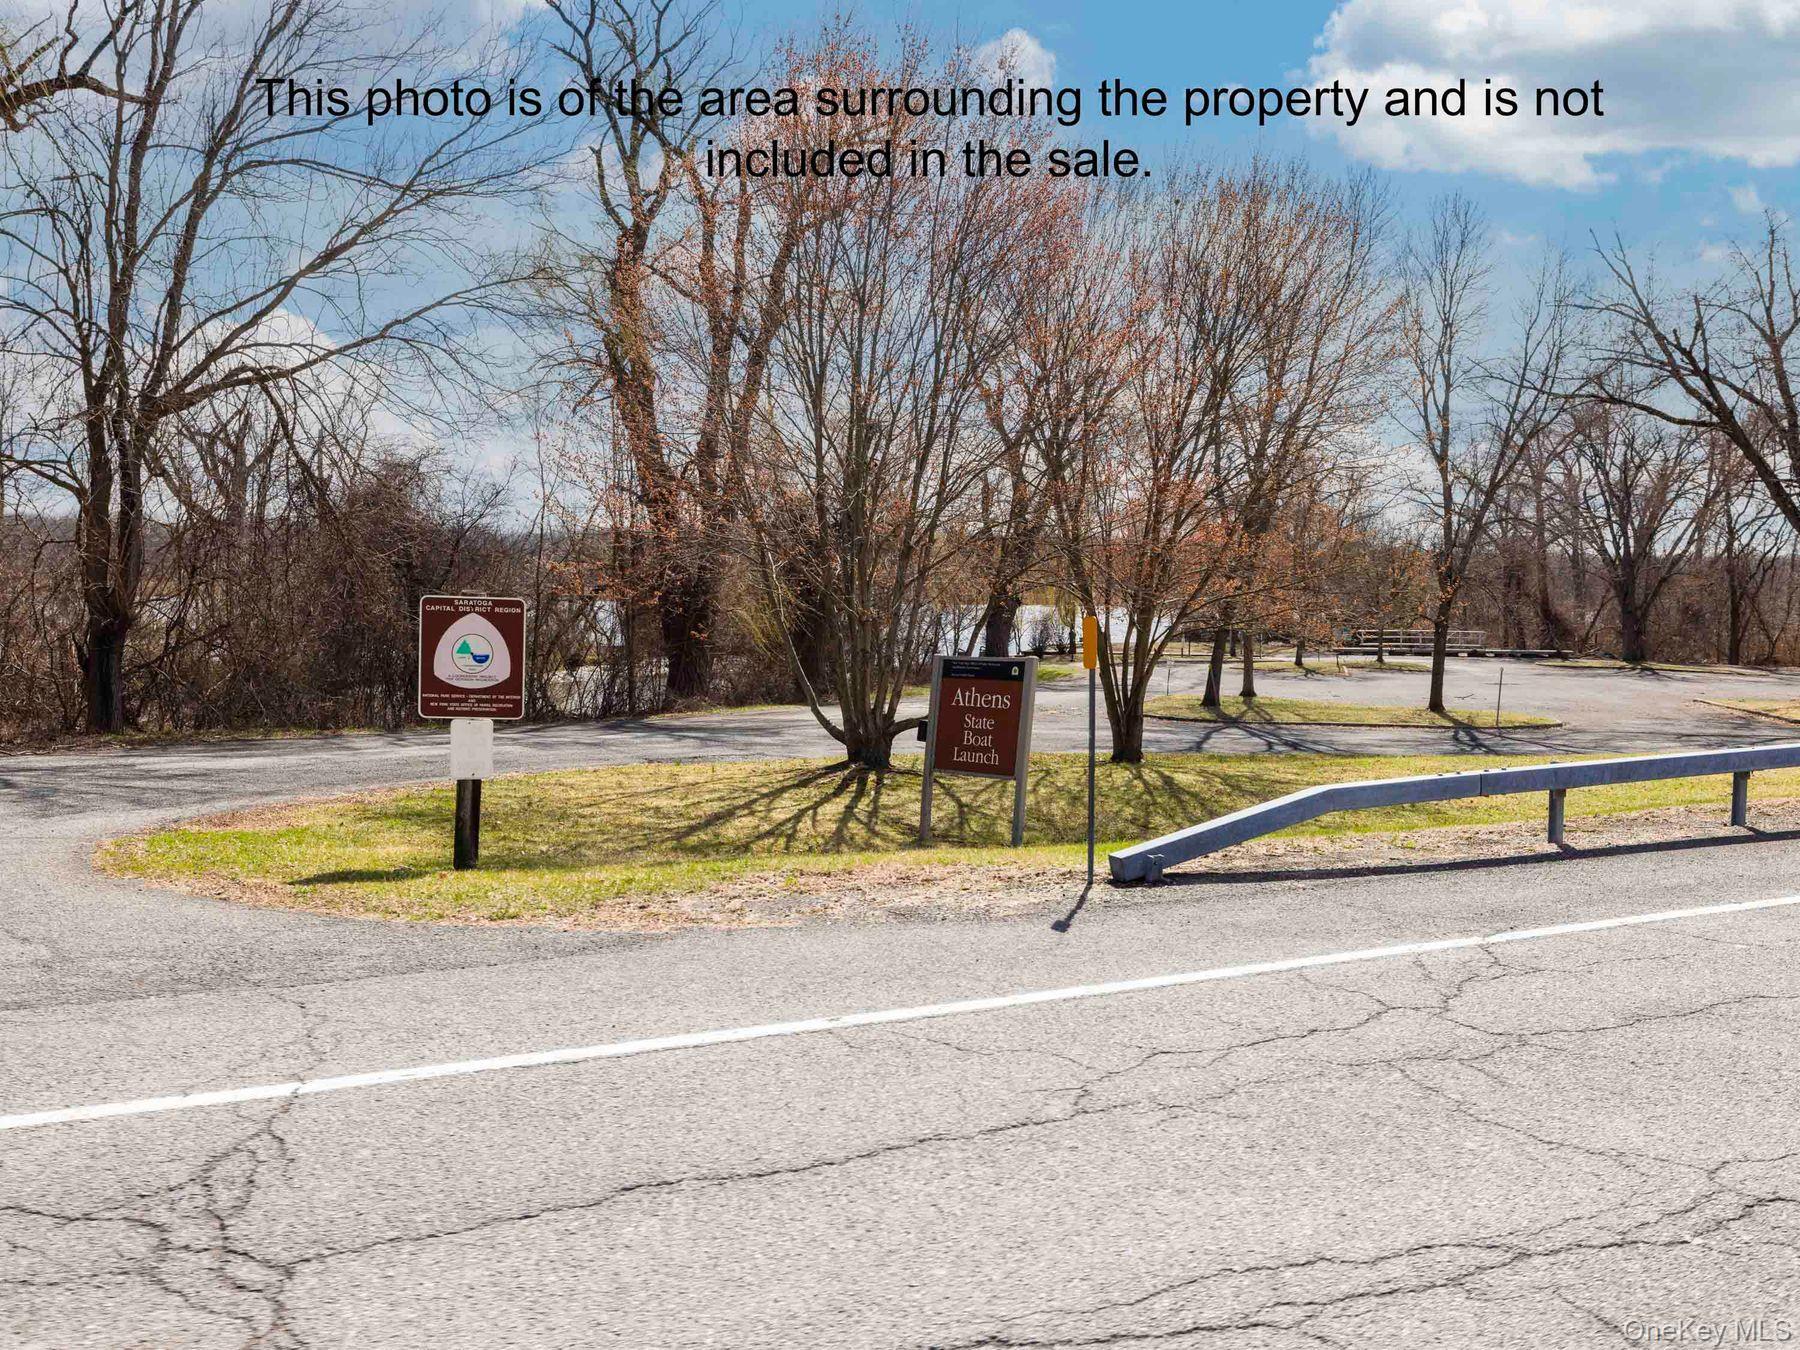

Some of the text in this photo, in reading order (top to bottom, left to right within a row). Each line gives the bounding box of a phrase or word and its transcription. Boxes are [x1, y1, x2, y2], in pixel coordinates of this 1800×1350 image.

[425, 604, 455, 612] CAPITAL
[494, 606, 522, 614] REGION
[951, 687, 1011, 709] Athens
[964, 713, 995, 730] State
[963, 730, 993, 747] Boat
[953, 747, 999, 765] Launch
